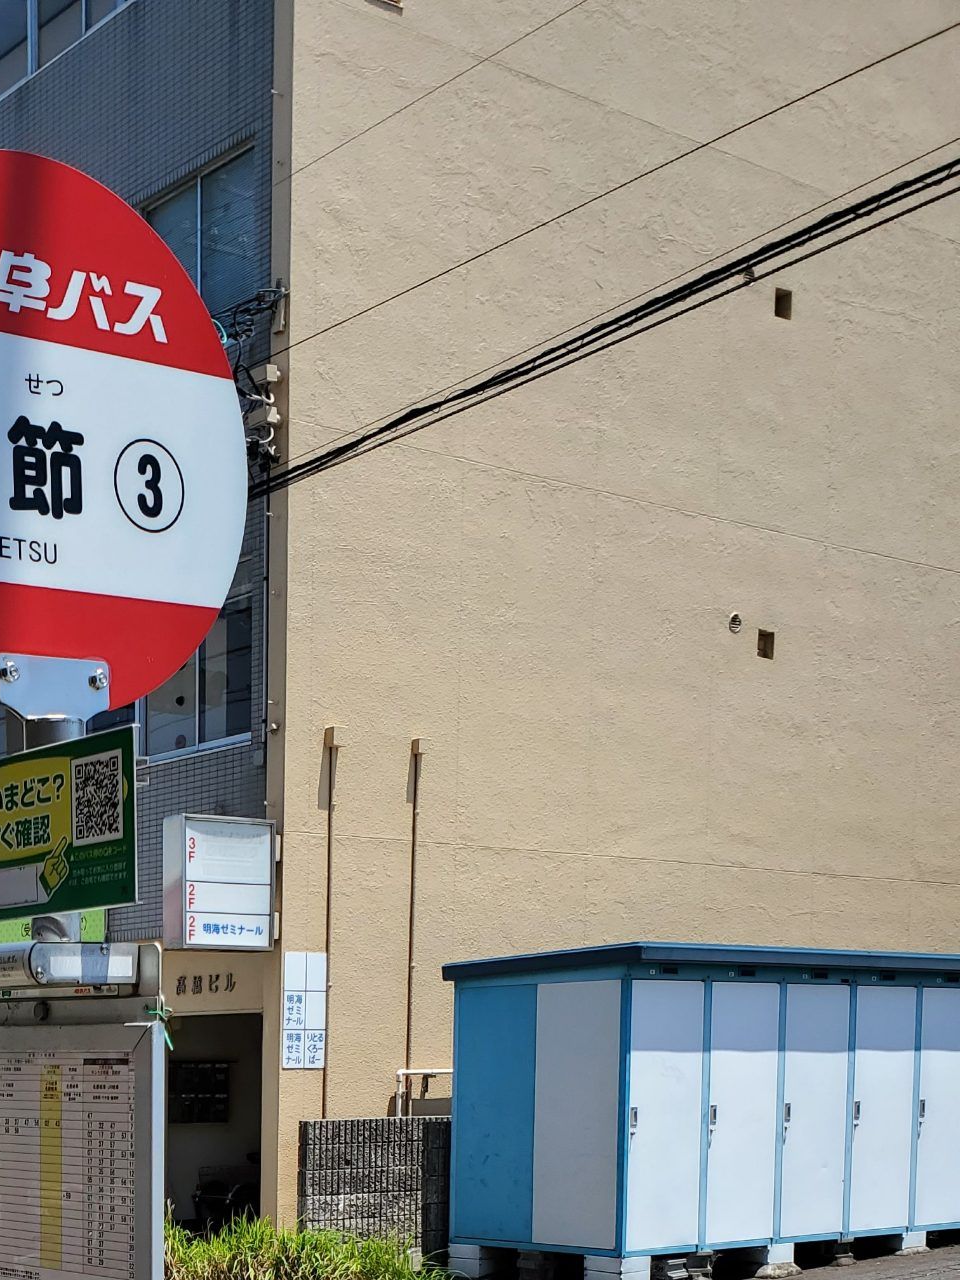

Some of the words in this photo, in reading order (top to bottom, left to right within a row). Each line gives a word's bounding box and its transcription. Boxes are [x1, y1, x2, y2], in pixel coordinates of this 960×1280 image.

[25, 373, 64, 396] せつ
[203, 923, 263, 936] 明海ゼミナール
